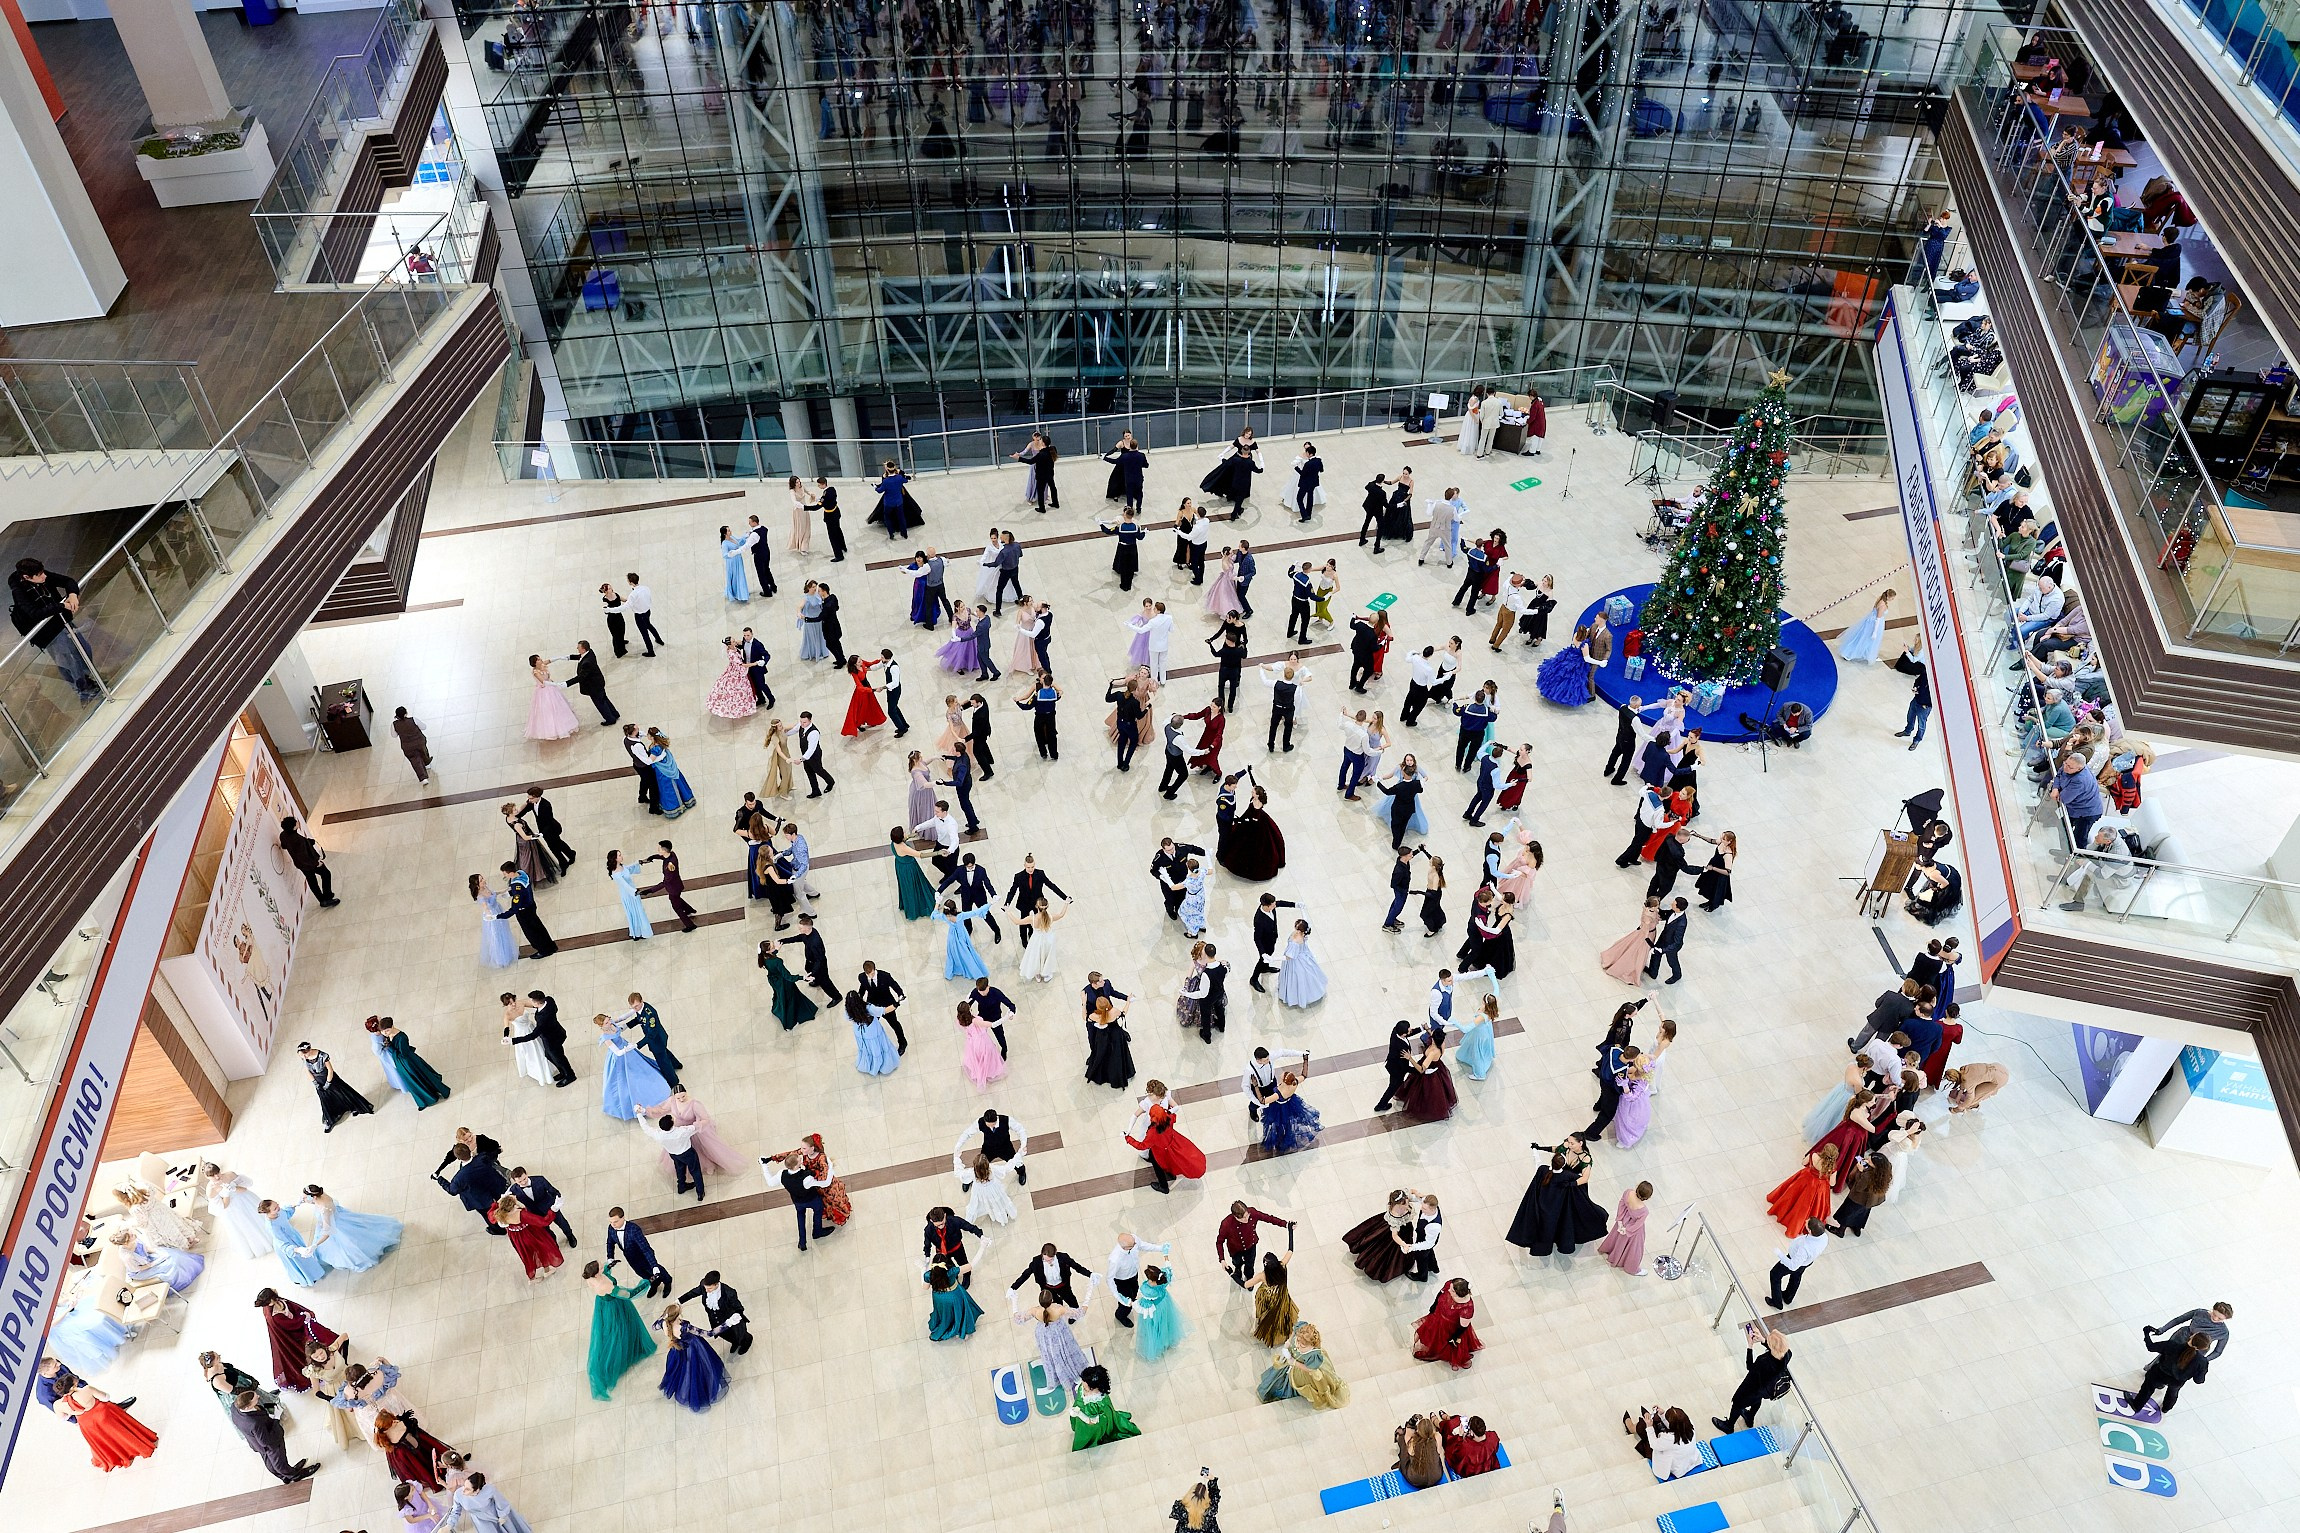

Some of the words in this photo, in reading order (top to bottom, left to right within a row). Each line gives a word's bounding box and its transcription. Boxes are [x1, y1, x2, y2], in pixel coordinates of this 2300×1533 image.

[1906, 463, 1917, 488] Я
[1909, 474, 1934, 565] ВЫБИРАЮ
[1924, 552, 1948, 650] РОССИЮ!
[36, 1061, 109, 1248] РОССИЮ!
[994, 1363, 1026, 1403] D
[2091, 1385, 2136, 1417] B
[2100, 1422, 2144, 1454] C
[2104, 1453, 2150, 1490] D
